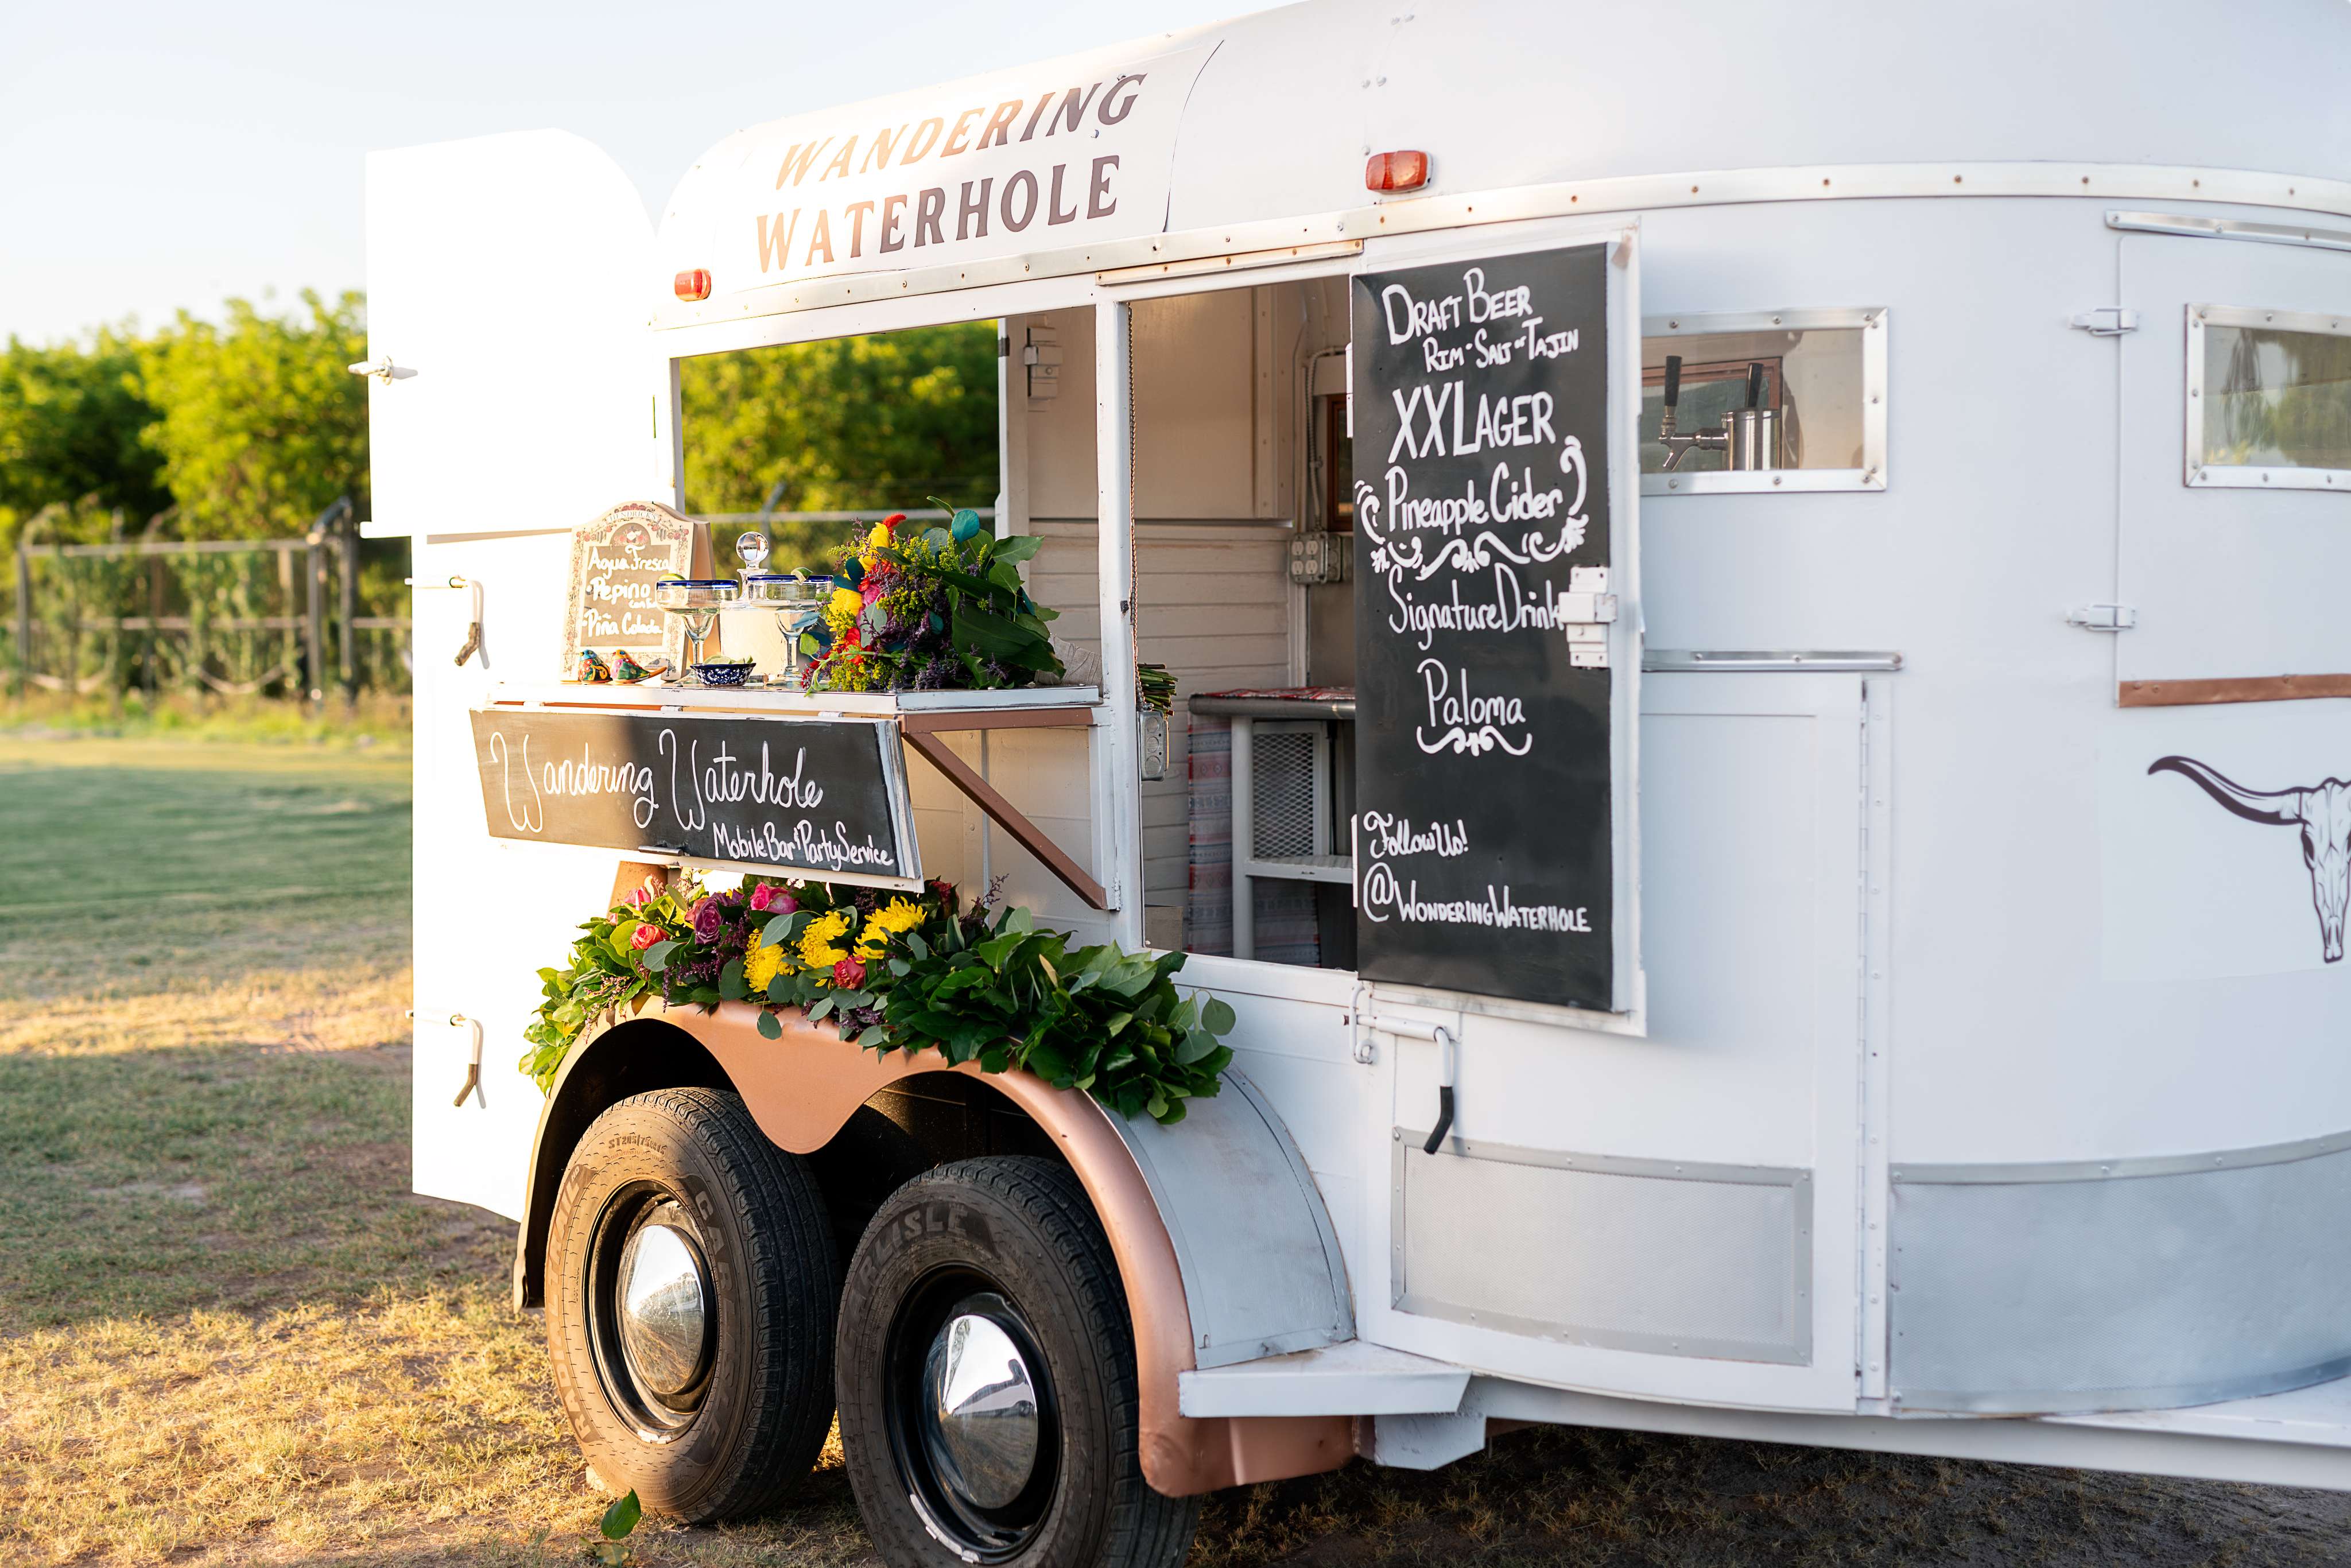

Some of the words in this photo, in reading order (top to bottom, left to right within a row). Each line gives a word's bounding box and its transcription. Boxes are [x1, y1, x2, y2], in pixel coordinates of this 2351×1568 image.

[775, 72, 1148, 190] WANDERING
[756, 154, 1120, 273] WATERHOLE
[1382, 284, 1463, 345] DRAFT
[1463, 267, 1533, 323] BEER
[1422, 336, 1465, 373] RIM
[1522, 316, 1579, 360] TAJIN
[610, 511, 656, 521] HENDRICK'S
[1384, 465, 1489, 535] Pineapple
[1490, 461, 1563, 523] Cider
[587, 546, 630, 580] Agua
[589, 576, 650, 605] Pepino
[584, 608, 619, 638] Piña
[622, 612, 664, 635] Colada
[1388, 564, 1503, 651] Signature
[1417, 658, 1526, 727] Paloma
[490, 732, 659, 833] Wandering
[658, 728, 824, 831] Waterhole
[712, 821, 767, 859] Mobile
[763, 821, 796, 861] Bar
[796, 819, 841, 872] Party
[835, 821, 894, 866] Service
[1363, 810, 1436, 859] Follow
